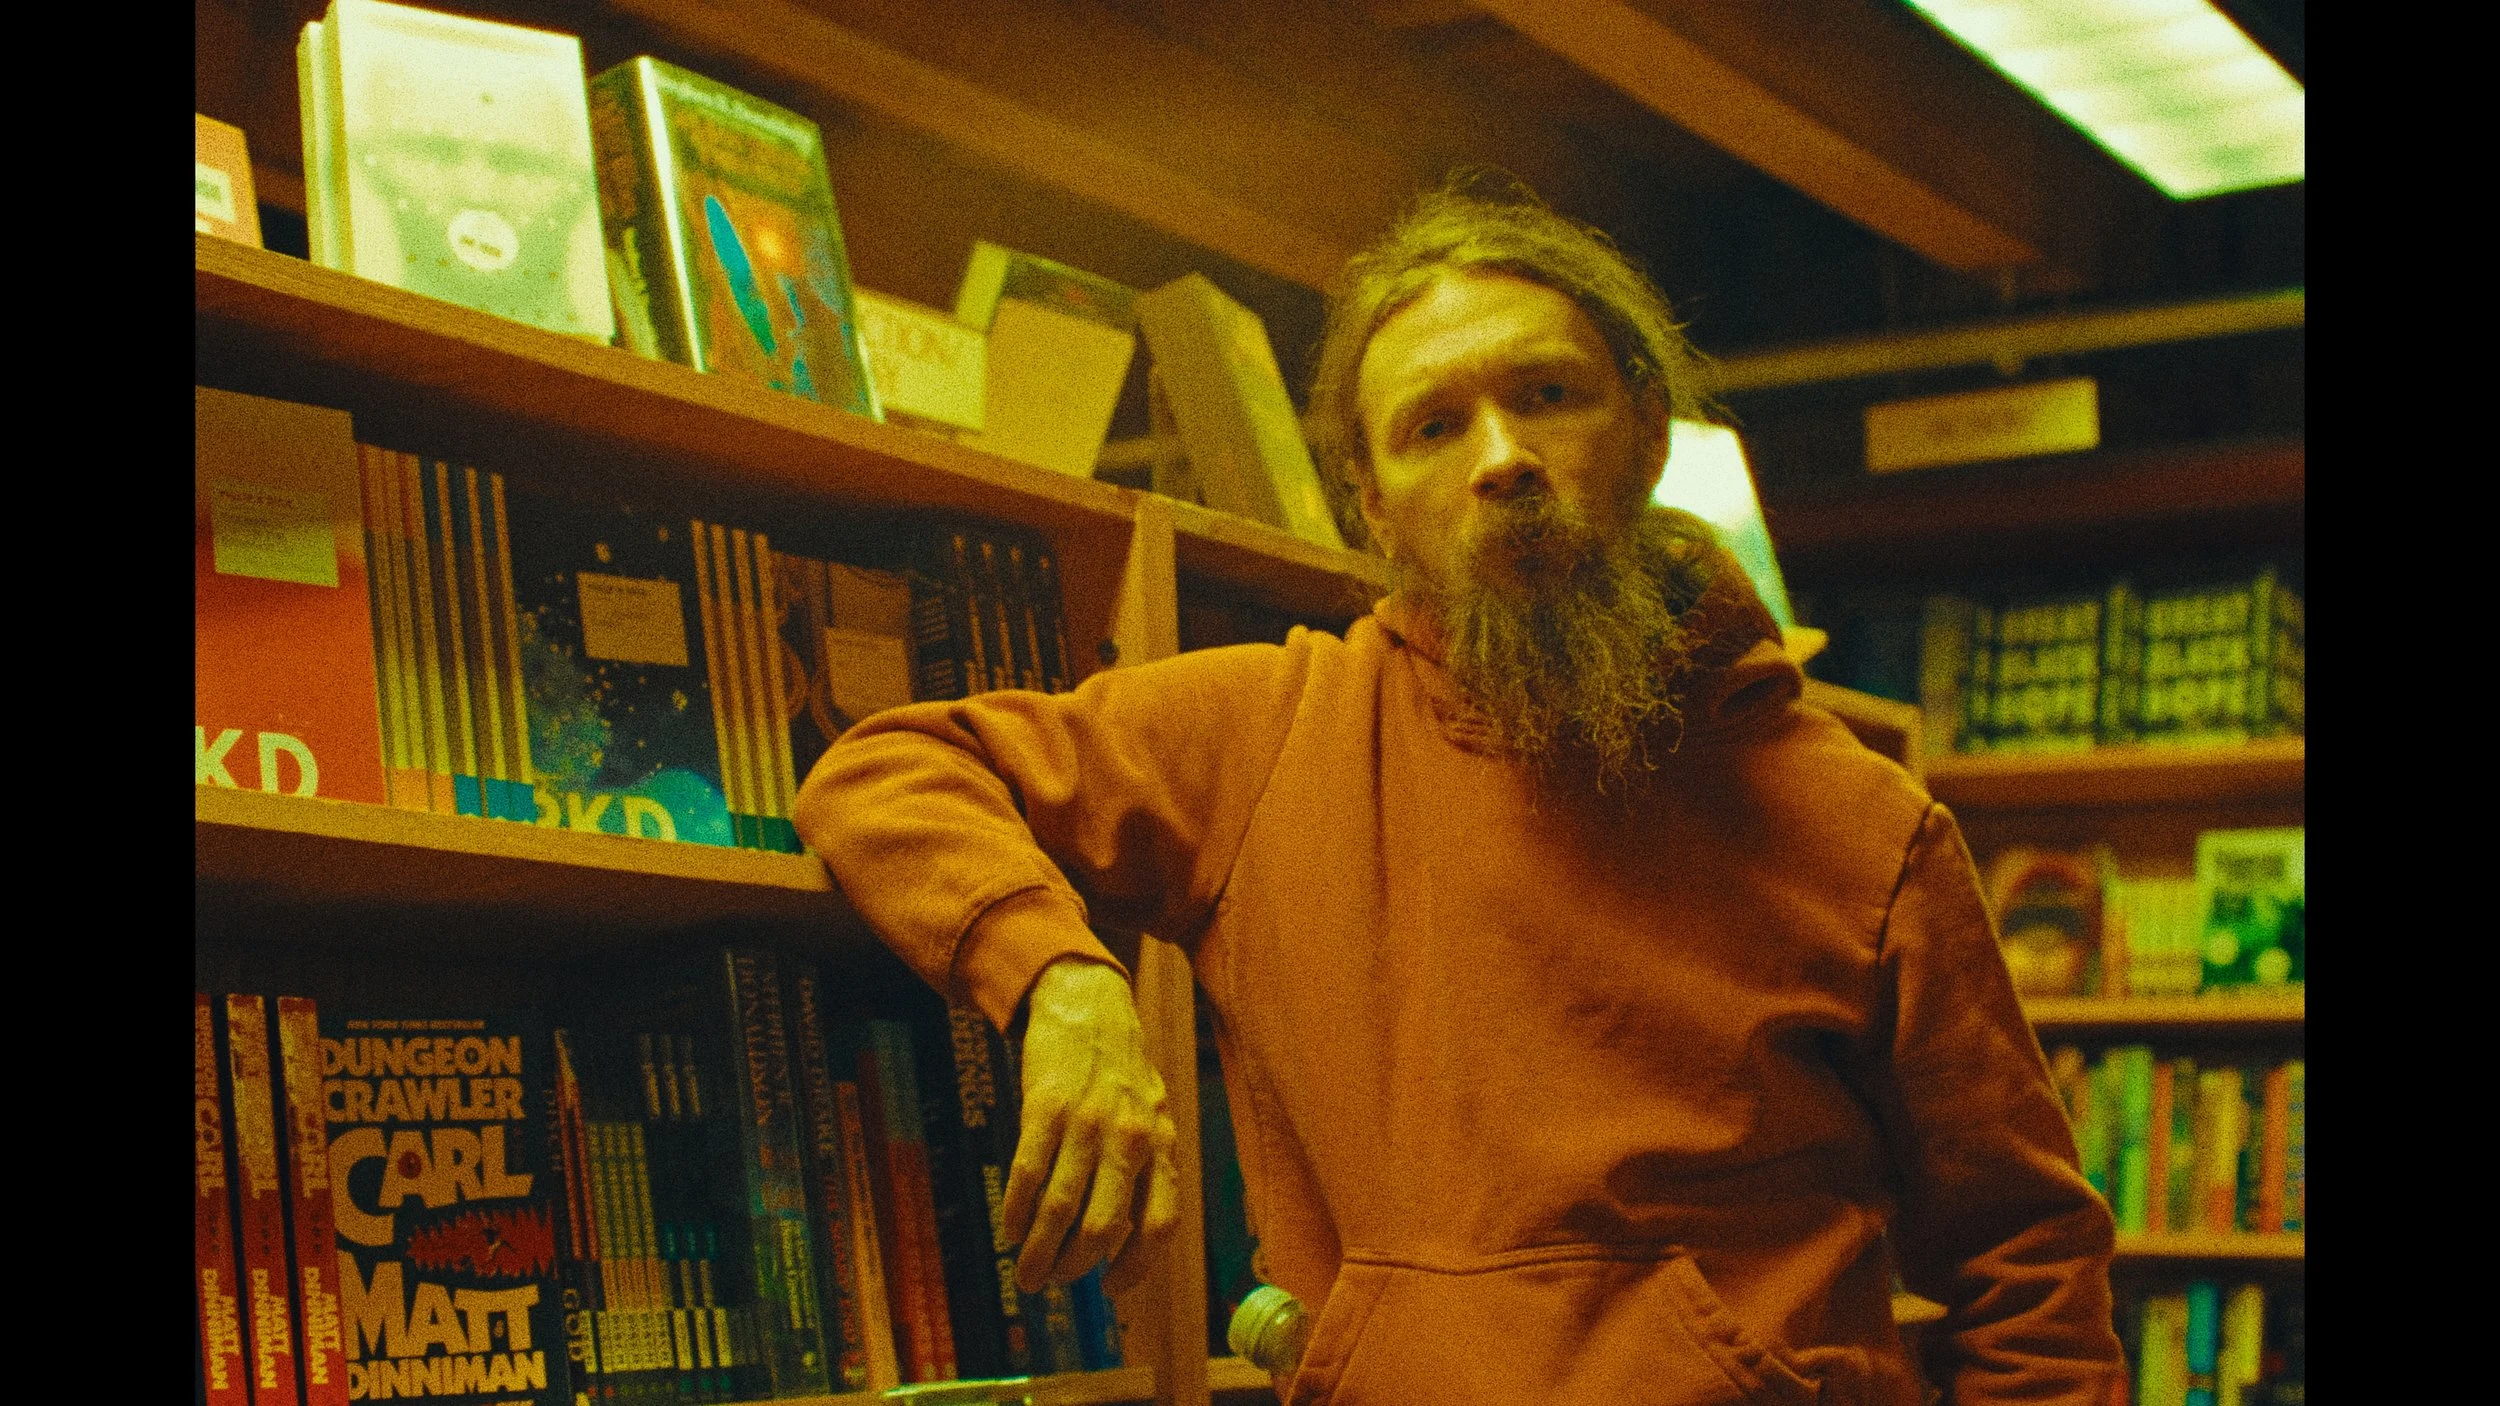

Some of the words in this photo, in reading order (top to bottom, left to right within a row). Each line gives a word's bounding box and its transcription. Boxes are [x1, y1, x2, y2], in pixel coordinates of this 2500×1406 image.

[319, 1037, 521, 1077] DUNGEON
[737, 956, 774, 1127] DONALDSON
[950, 1005, 988, 1129] DDINGS
[195, 1098, 227, 1198] CARL
[324, 1078, 525, 1122] CRAWLER
[329, 1125, 534, 1246] CARL
[203, 1268, 229, 1390] DINNIMAN
[220, 1295, 240, 1355] MATT
[253, 1268, 278, 1389] DINNIMAN
[269, 1295, 289, 1355] MATT
[304, 1267, 329, 1385] DINNIMAN
[321, 1293, 341, 1351] MATT
[338, 1250, 540, 1360] MATT
[563, 1287, 585, 1362] GOD
[347, 1350, 548, 1400] DINNIMAN
